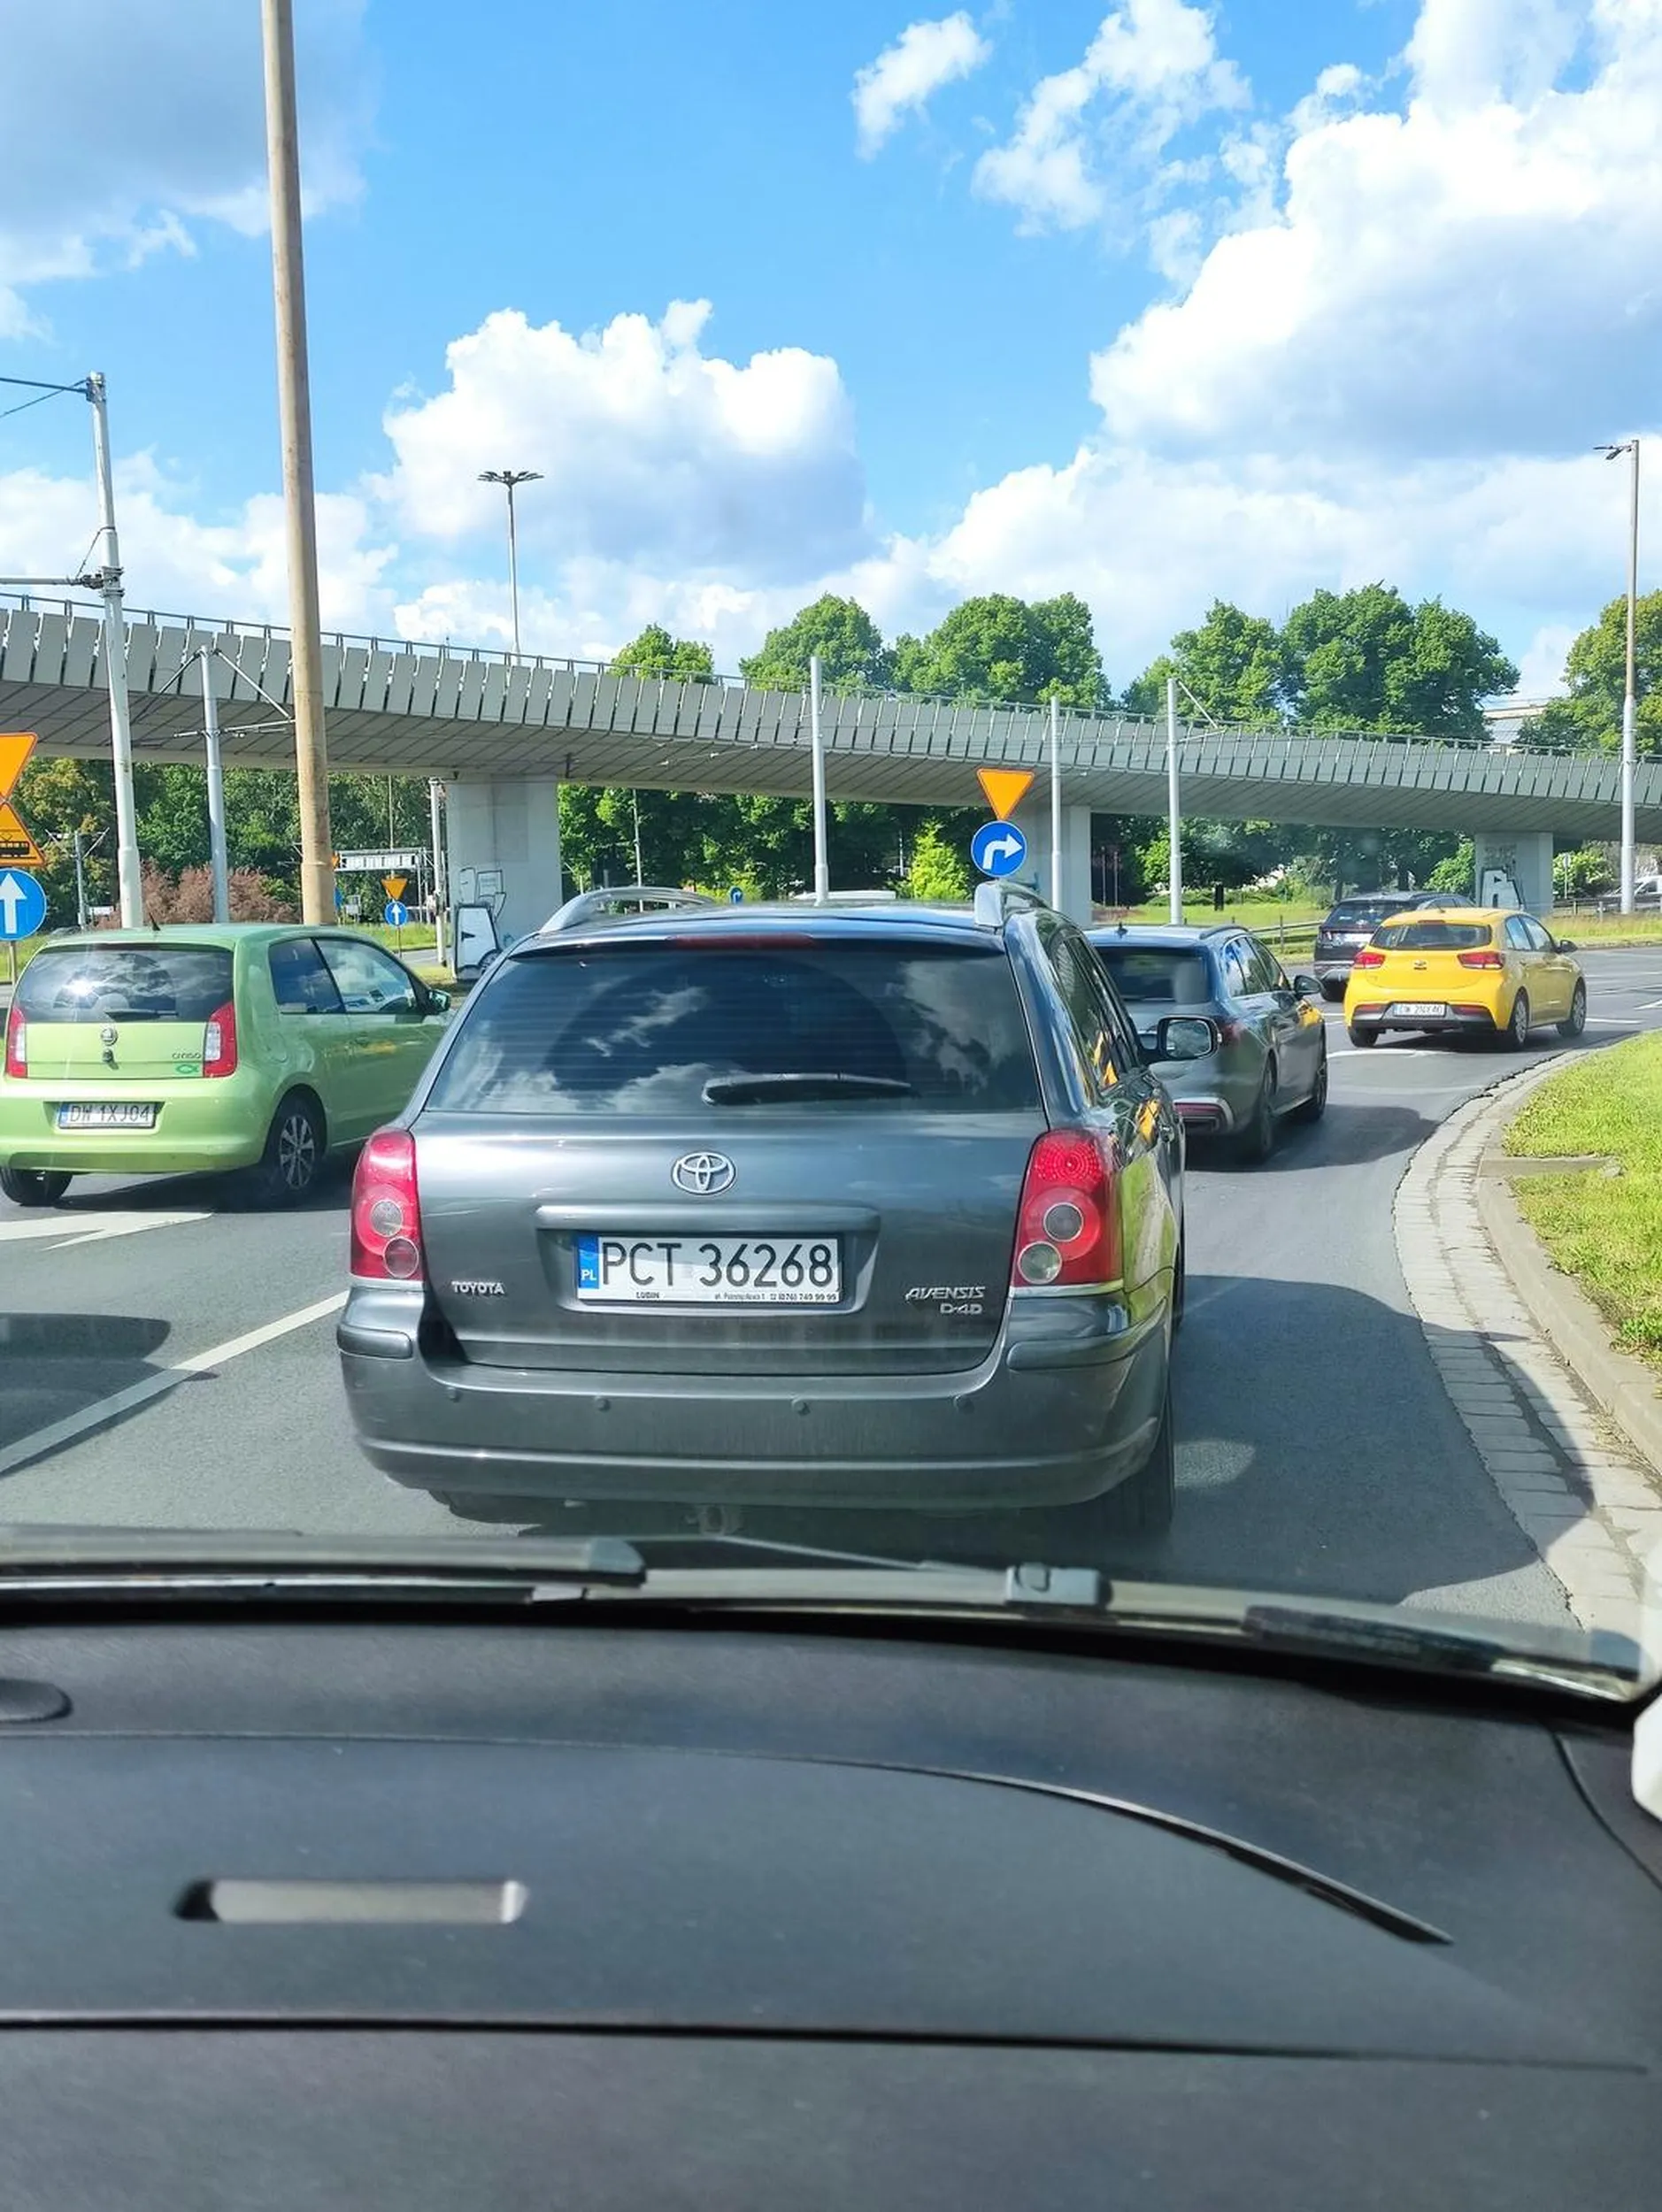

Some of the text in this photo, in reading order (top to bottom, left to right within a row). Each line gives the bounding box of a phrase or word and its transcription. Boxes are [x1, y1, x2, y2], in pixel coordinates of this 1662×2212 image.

[70, 1104, 150, 1122] DW 1XJ04
[602, 1242, 833, 1287] PCT 36268
[581, 1269, 597, 1281] PL
[450, 1280, 504, 1295] TOYOTA
[904, 1286, 986, 1301] AVENSIS
[940, 1302, 983, 1315] D-4D
